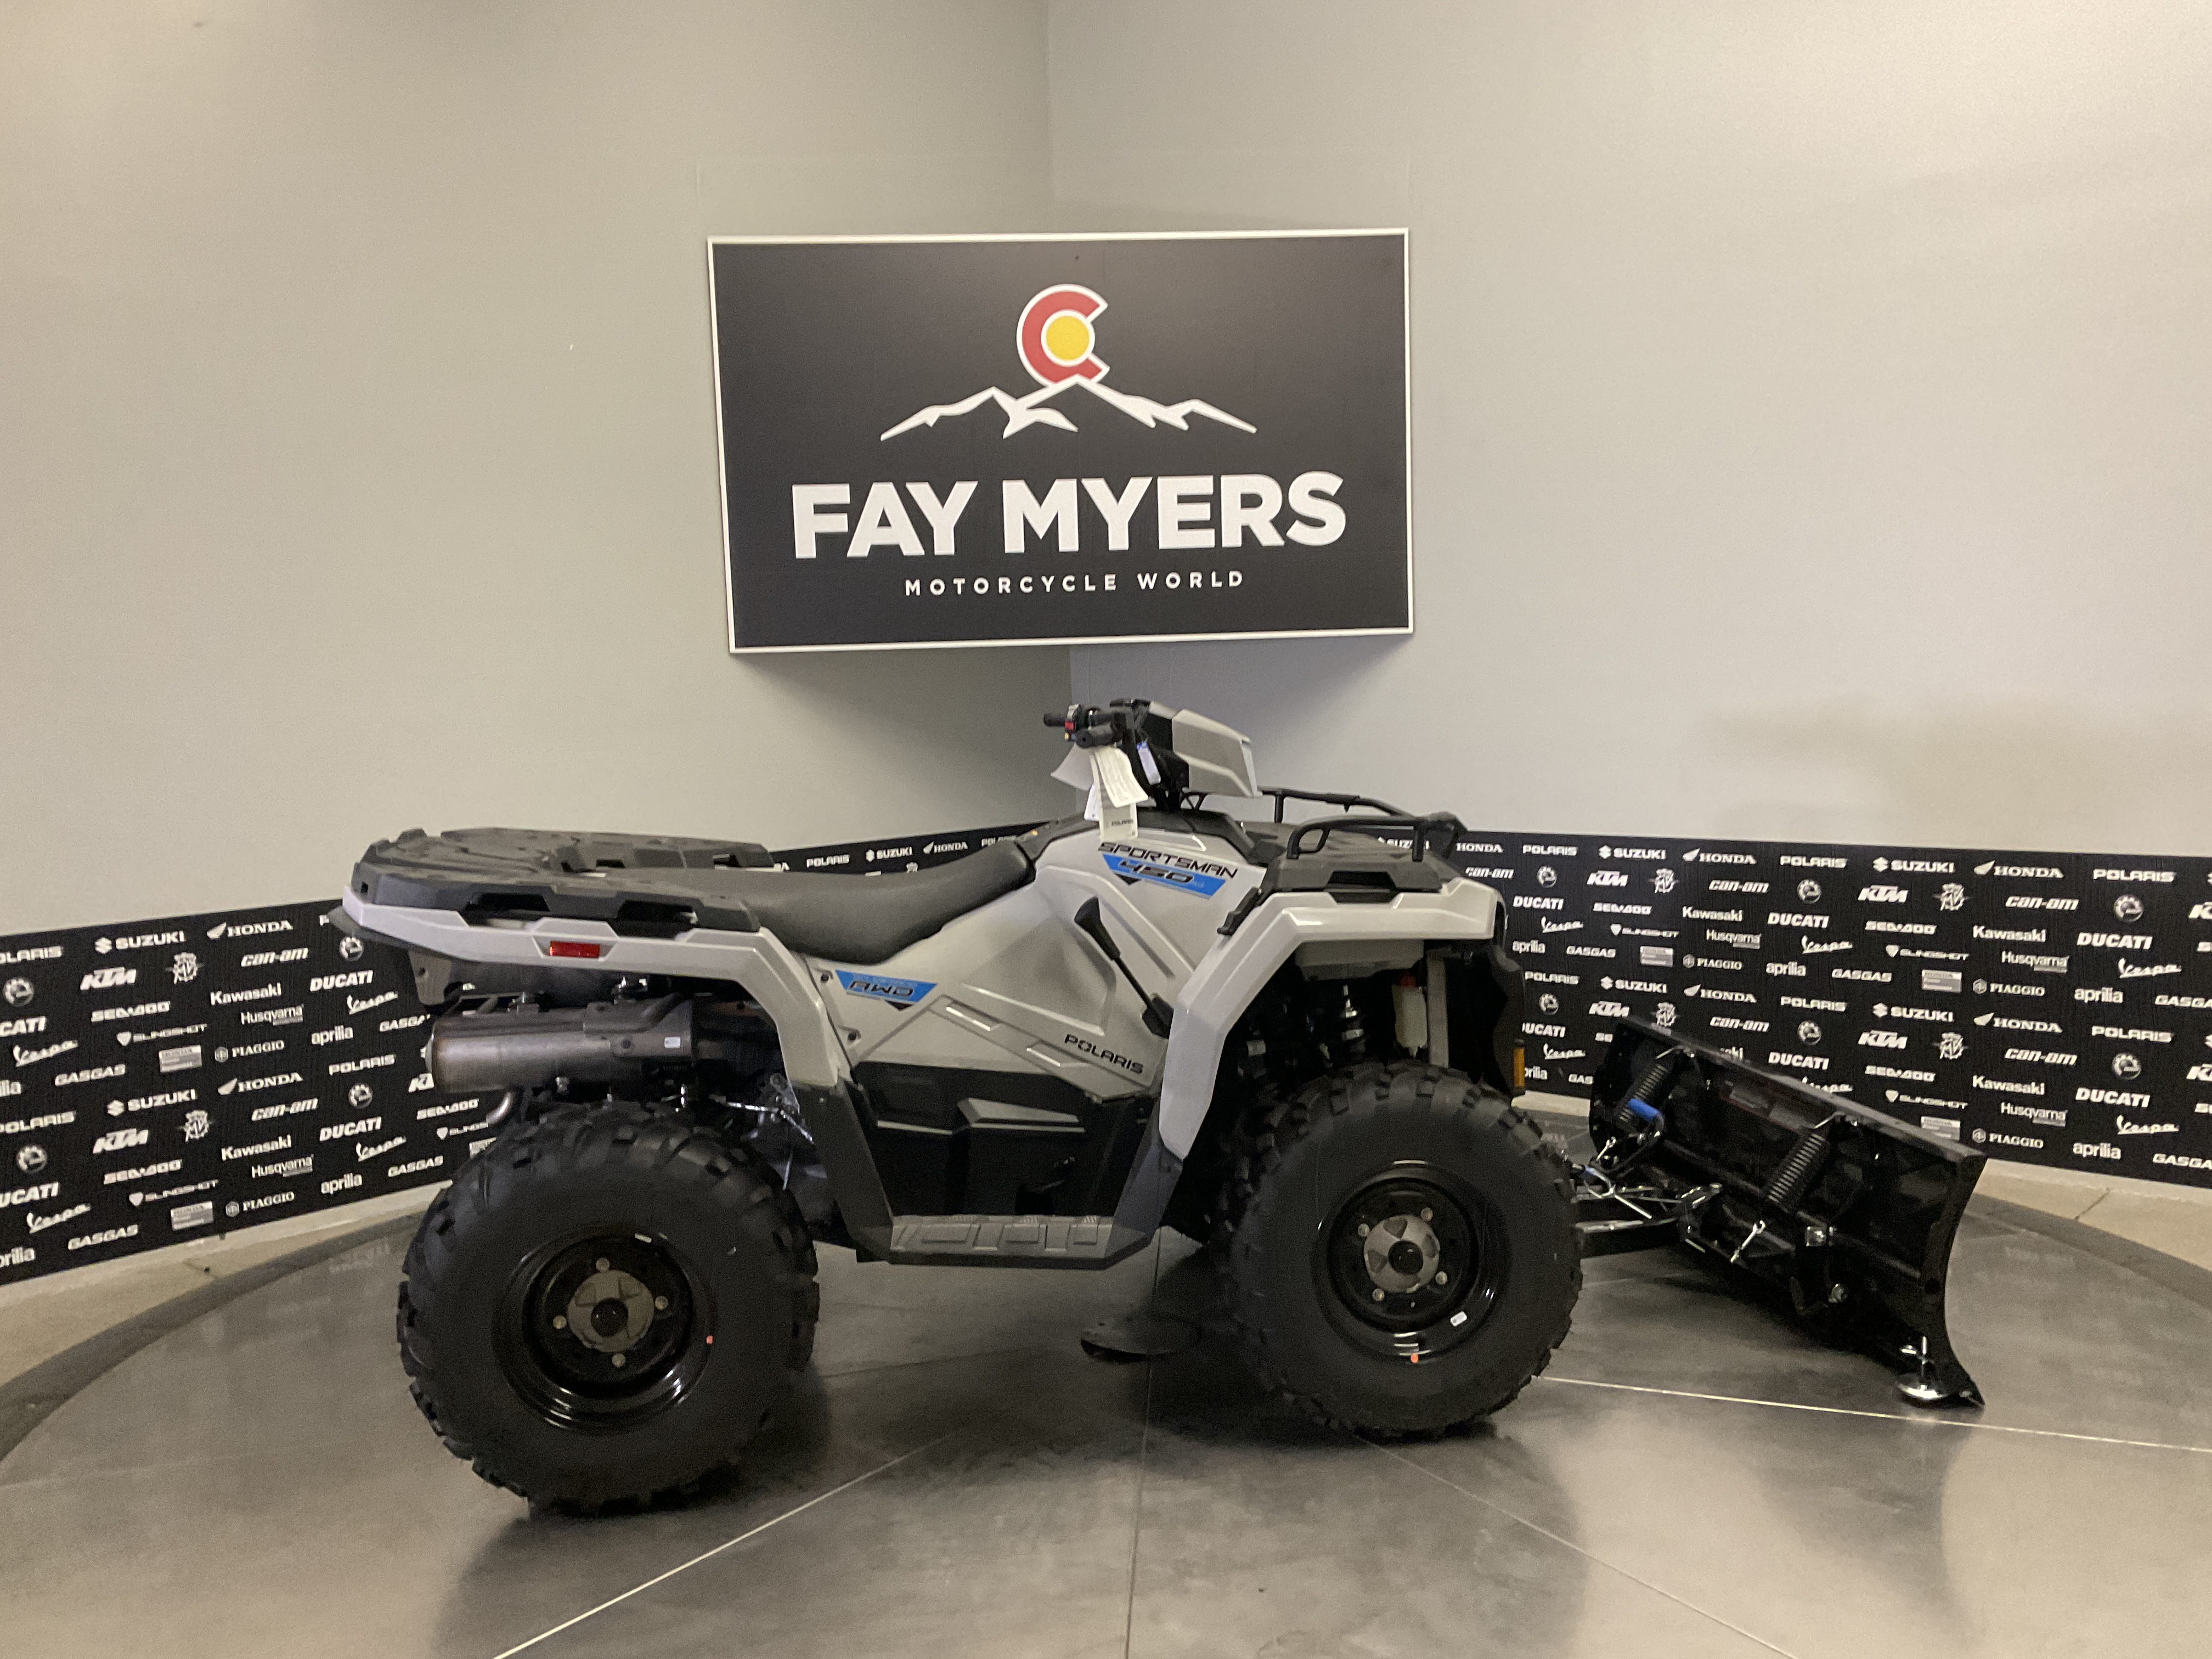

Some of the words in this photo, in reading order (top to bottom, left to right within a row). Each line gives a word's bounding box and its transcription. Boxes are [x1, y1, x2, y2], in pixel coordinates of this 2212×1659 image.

[792, 481, 978, 558] FAY
[1003, 471, 1346, 553] MYERS
[906, 574, 1116, 595] MOTORCYCLE
[1137, 571, 1242, 589] WORLD
[876, 847, 912, 860] SUZUKI
[934, 842, 968, 853] HONDA
[1456, 843, 1503, 853] HONDA
[1522, 844, 1577, 856] POLARIS
[1613, 848, 1666, 860] SUZUKI
[806, 854, 850, 868] POLARIS
[1098, 842, 1239, 879] SPORTSMAN
[1699, 853, 1756, 865] HONDA
[1780, 855, 1847, 868] POLARIS
[1891, 860, 1954, 873] SUZUKI
[1118, 859, 1194, 884] 450
[1587, 870, 1628, 887] KTM
[1994, 866, 2063, 878] HONDA
[2093, 868, 2175, 883] POLARIS
[1513, 895, 1564, 910] DUCATI
[1858, 885, 1909, 903] KTM
[1682, 906, 1743, 922] Kawasaki
[1767, 912, 1830, 929] DUCATI
[227, 920, 294, 937] HONDA
[1541, 916, 1584, 933] Vespa
[115, 930, 186, 950] SUZUKI
[1706, 929, 1762, 944] Husqvarna
[1973, 925, 2046, 943] Kawasaki
[2076, 932, 2153, 950] DUCATI
[1512, 939, 1546, 954] aprilia
[1566, 946, 1616, 958] GASGAS
[1801, 935, 1853, 954] Vespa
[0, 946, 63, 964] OLARIS
[1697, 958, 1742, 970] PIAGGIO
[2001, 951, 2069, 967] Husqvarna
[1765, 961, 1807, 977] aprilia
[1831, 968, 1892, 983] GASGAS
[2118, 957, 2182, 979] Vespa
[80, 967, 137, 990] KTM
[309, 970, 374, 992] DUCATI
[1525, 971, 1579, 985] POLARIS
[1615, 979, 1667, 994] SUZUKI
[210, 982, 282, 1006] Kawasaki
[1700, 989, 1757, 1003] HONDA
[1990, 983, 2045, 996] PIAGGIO
[2074, 986, 2123, 1003] aprilia
[347, 991, 398, 1015] Vespa
[1588, 1001, 1630, 1018] KTM
[1780, 996, 1847, 1012] POLARIS
[2154, 995, 2212, 1008] GASGA
[241, 1005, 304, 1026] Husqvarna
[379, 1014, 431, 1032] GASGA
[1891, 1006, 1954, 1023] SUZUKI
[0, 1015, 47, 1037] CATI
[1522, 1023, 1566, 1038] UCATI
[1993, 1017, 2063, 1033] HONDA
[2091, 1025, 2172, 1043] POLARIS
[311, 1025, 354, 1046] aprilia
[1858, 1030, 1908, 1049] KTM
[13, 1040, 78, 1067] Vespa
[232, 1040, 285, 1058] PIAGGIO
[1064, 1034, 1144, 1074] POLARIS
[1543, 1043, 1585, 1060] Vespa
[329, 1054, 395, 1076] POLARIS
[1768, 1052, 1830, 1070] DUCATI
[54, 1064, 126, 1086] GASGAS
[238, 1072, 303, 1092] HONDA
[1524, 1065, 1548, 1081] rilia
[1568, 1074, 1594, 1085] GAS
[408, 1072, 435, 1093] KT
[1972, 1075, 2045, 1096] Kawasaki
[127, 1088, 196, 1111] SUZUKI
[2075, 1087, 2151, 1108] DUCATI
[2001, 1102, 2068, 1122] Husqvarna
[0, 1111, 76, 1134] OLARIS
[319, 1116, 382, 1142] DUCATI
[2116, 1115, 2179, 1135] Vespa
[92, 1128, 149, 1154] KTM
[221, 1134, 292, 1161] Kawasaki
[356, 1136, 407, 1162] Vespa
[1989, 1133, 2044, 1149] PIAGGIO
[2073, 1142, 2121, 1160] aprilia
[251, 1154, 314, 1178] Husqvarna
[387, 1155, 443, 1177] GASGAS
[2152, 1153, 2212, 1170] GASGA
[321, 1172, 363, 1195] aprilia
[0, 1182, 59, 1208] UCATI
[242, 1191, 295, 1211] PIAGGIO
[26, 1204, 91, 1234] Vespa
[67, 1224, 138, 1250] GASGAS
[0, 1246, 36, 1268] rilia
